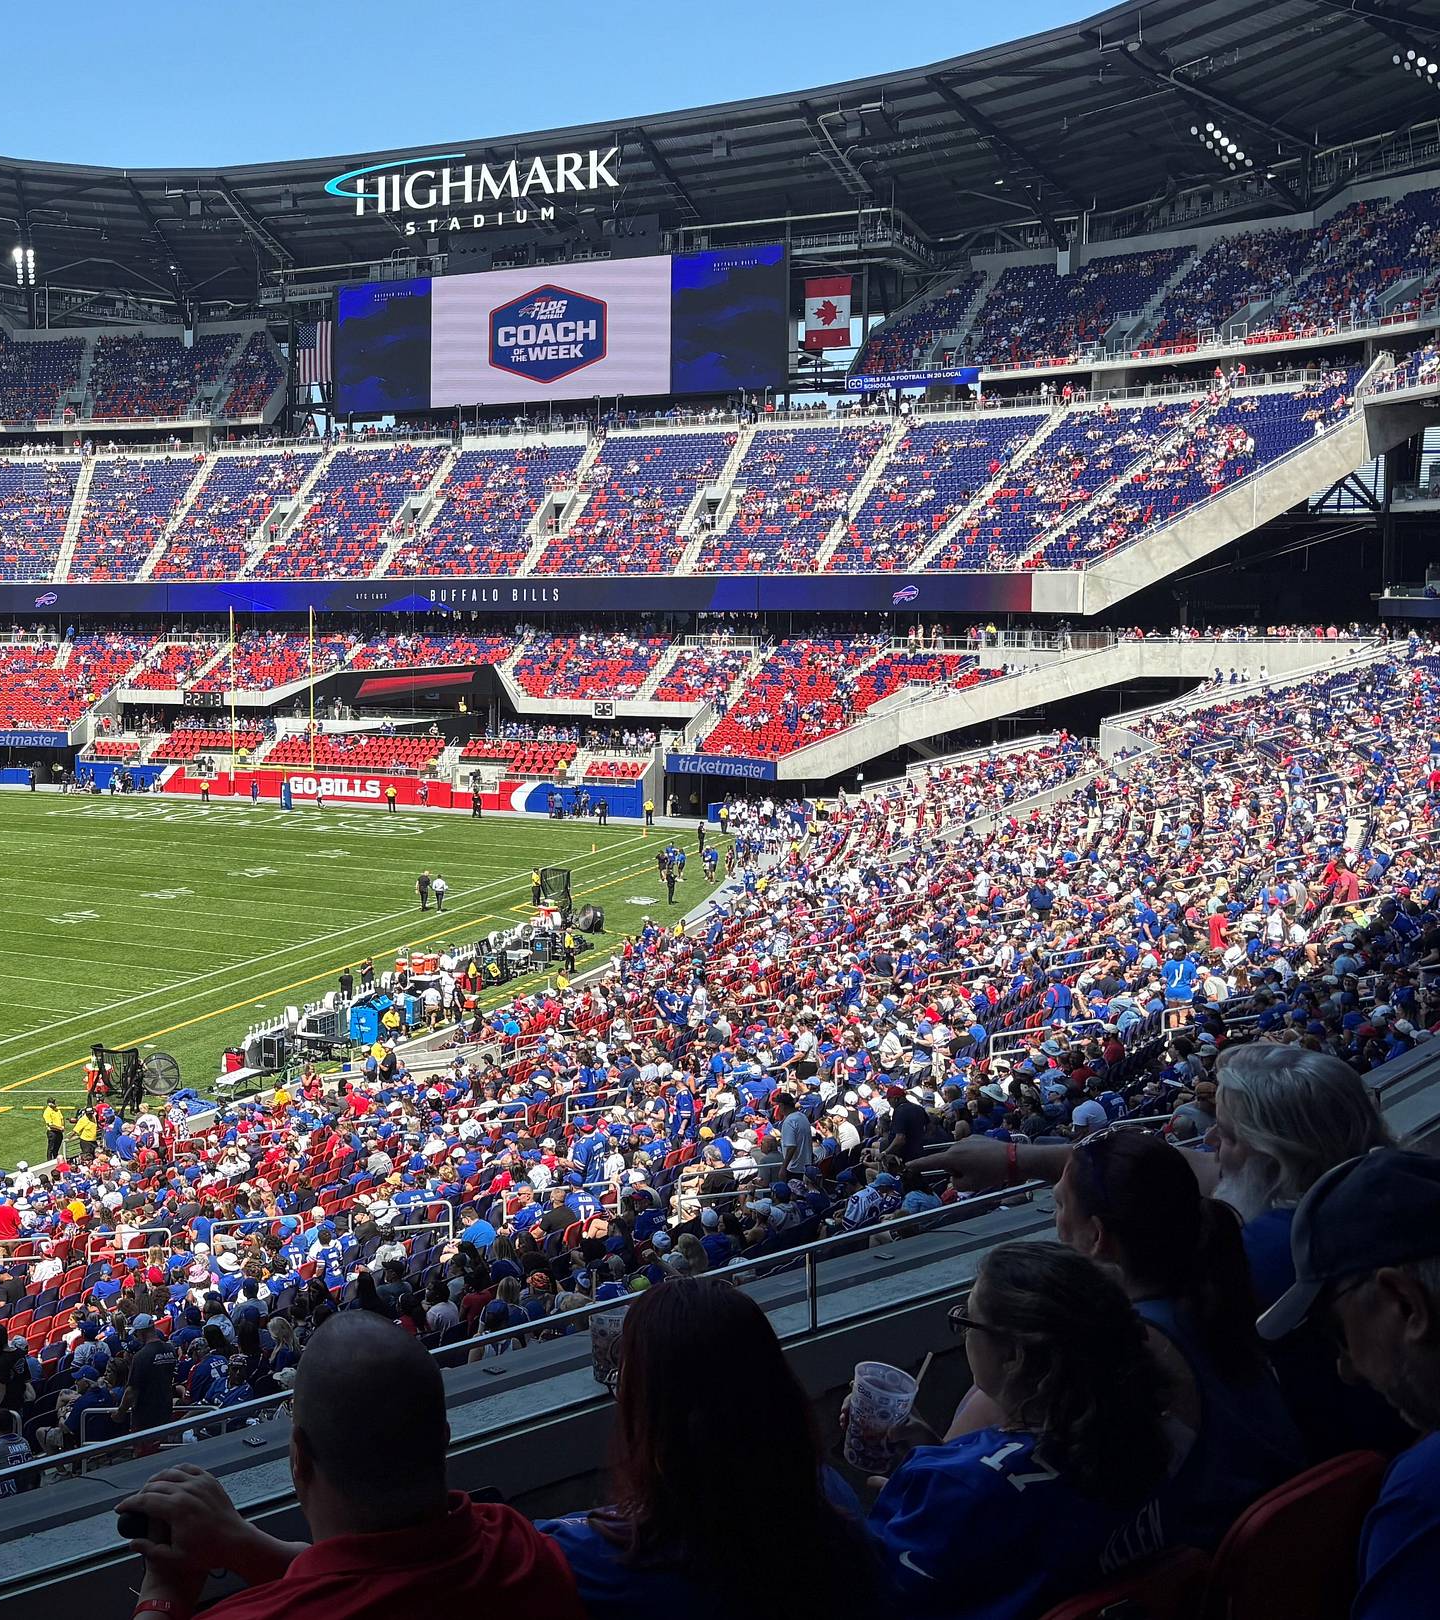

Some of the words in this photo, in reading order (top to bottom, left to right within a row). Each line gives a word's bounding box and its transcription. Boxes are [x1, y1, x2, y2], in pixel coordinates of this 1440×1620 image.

[356, 148, 620, 216] HIGHMARK
[406, 206, 555, 236] STADIUM
[498, 319, 596, 347] COACH
[511, 354, 527, 363] THE
[513, 348, 524, 356] OF
[528, 344, 584, 361] WEEK
[896, 373, 927, 381] FOOTBALL
[942, 370, 962, 378] LOCAL
[430, 589, 499, 602] BUFFALO
[512, 588, 560, 602] BILLS
[184, 692, 222, 707] 22:13
[595, 702, 613, 716] 25
[678, 756, 766, 779] ticketmaster
[289, 776, 317, 795] GO
[321, 777, 381, 799] BILLS
[578, 1204, 595, 1224] 17
[289, 1253, 303, 1270] 17
